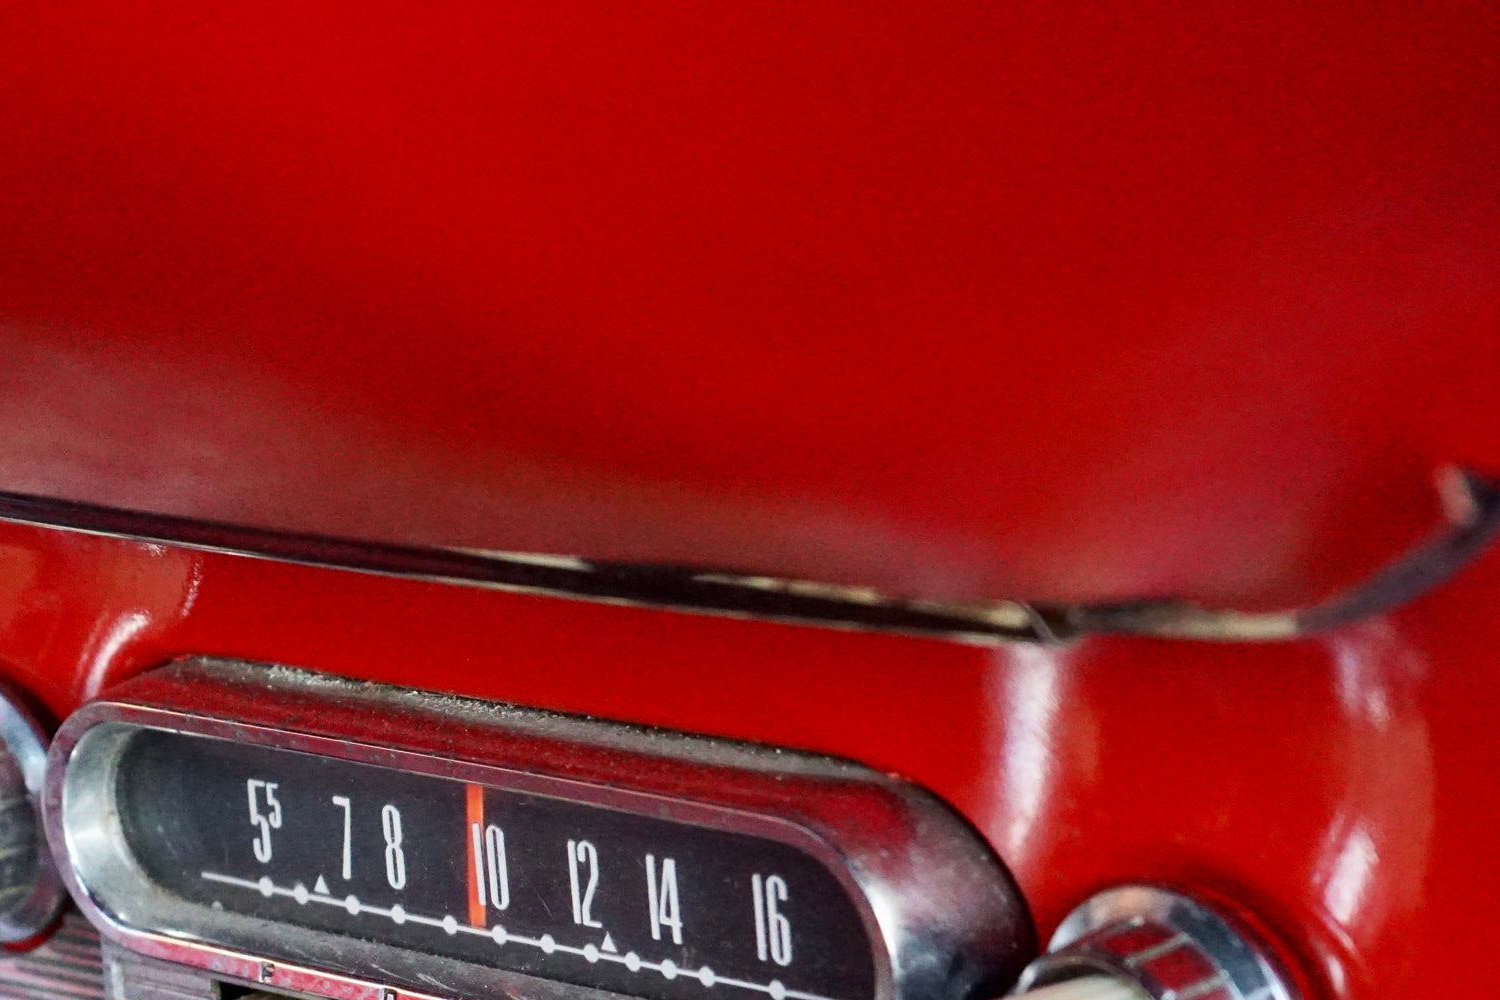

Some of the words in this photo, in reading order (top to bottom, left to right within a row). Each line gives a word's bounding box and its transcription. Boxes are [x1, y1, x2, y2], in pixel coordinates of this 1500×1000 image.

[247, 778, 282, 864] 55
[332, 795, 352, 880] 7
[381, 804, 407, 890] 8
[471, 822, 510, 910] 10
[567, 839, 603, 928] 12
[645, 853, 683, 945] 14
[752, 873, 793, 967] 16
